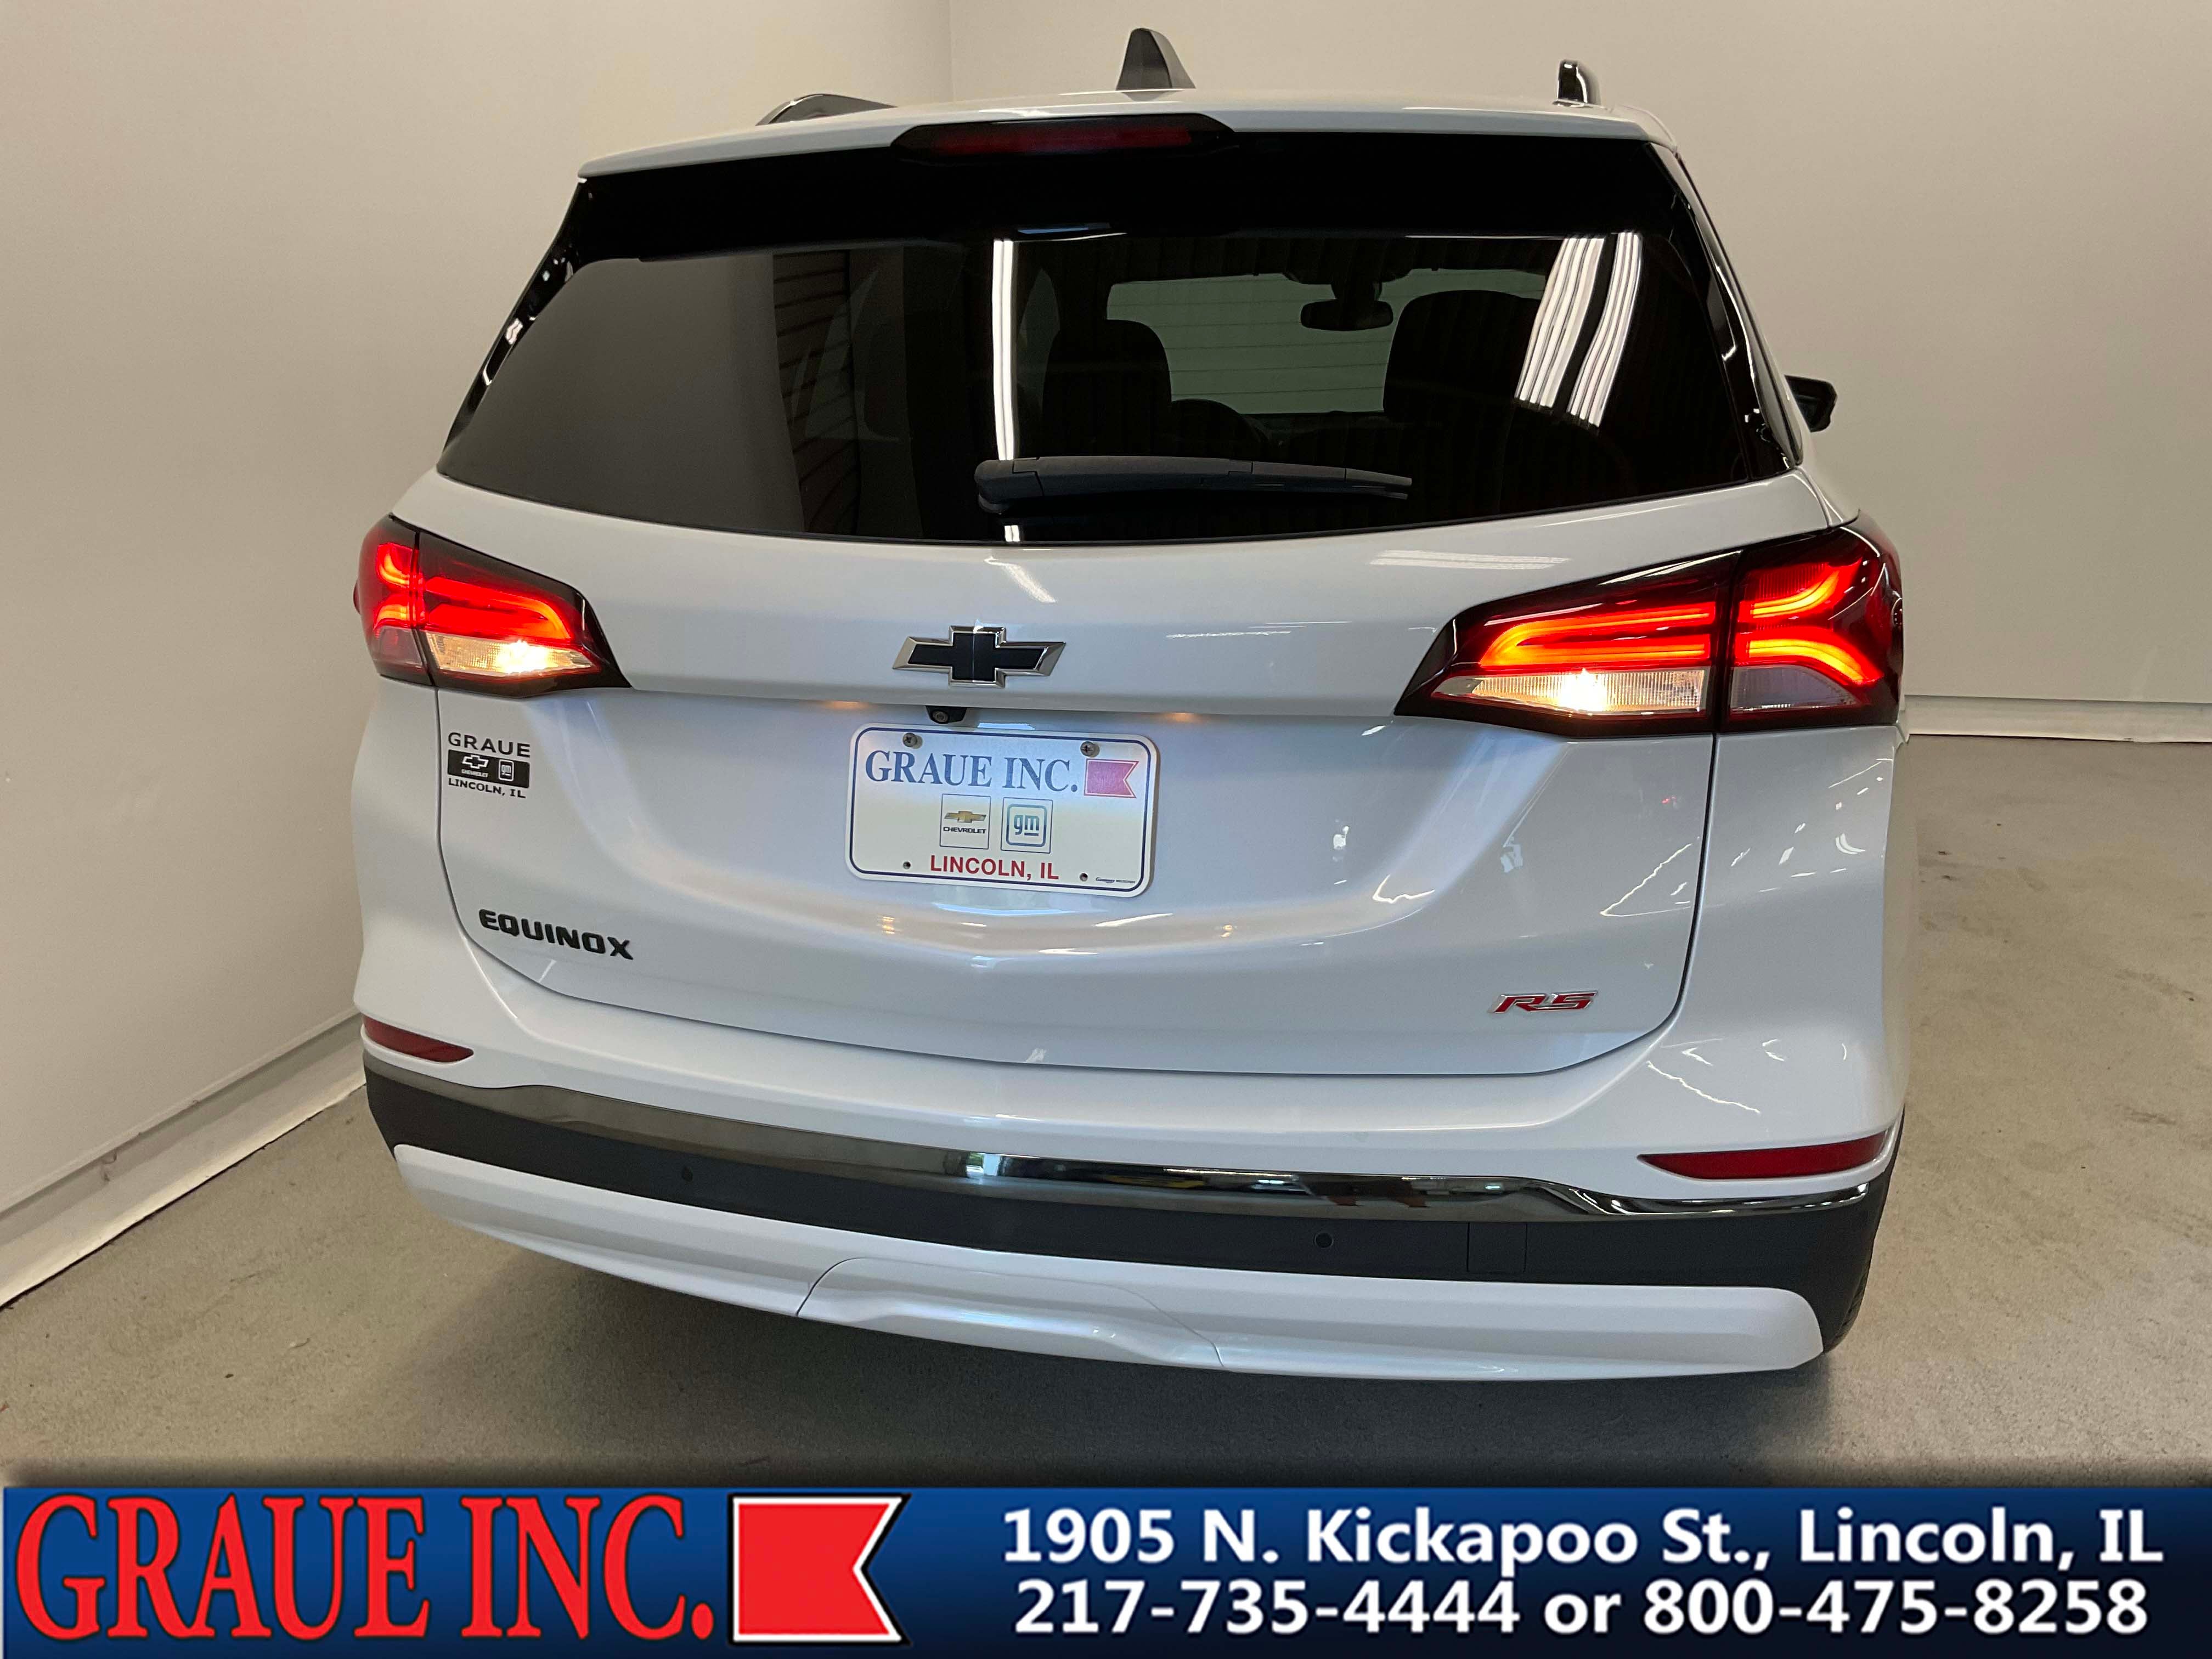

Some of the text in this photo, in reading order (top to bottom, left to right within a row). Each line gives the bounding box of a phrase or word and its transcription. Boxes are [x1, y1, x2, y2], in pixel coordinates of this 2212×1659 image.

[447, 732, 531, 758] GRAUE
[865, 749, 1079, 793] GRAUE INC.
[448, 777, 526, 799] LINCOLN, IL
[1013, 815, 1040, 836] gm
[930, 855, 1059, 881] LINCOLN, IL
[478, 909, 634, 960] EQUINOX
[1488, 990, 1598, 1014] RS
